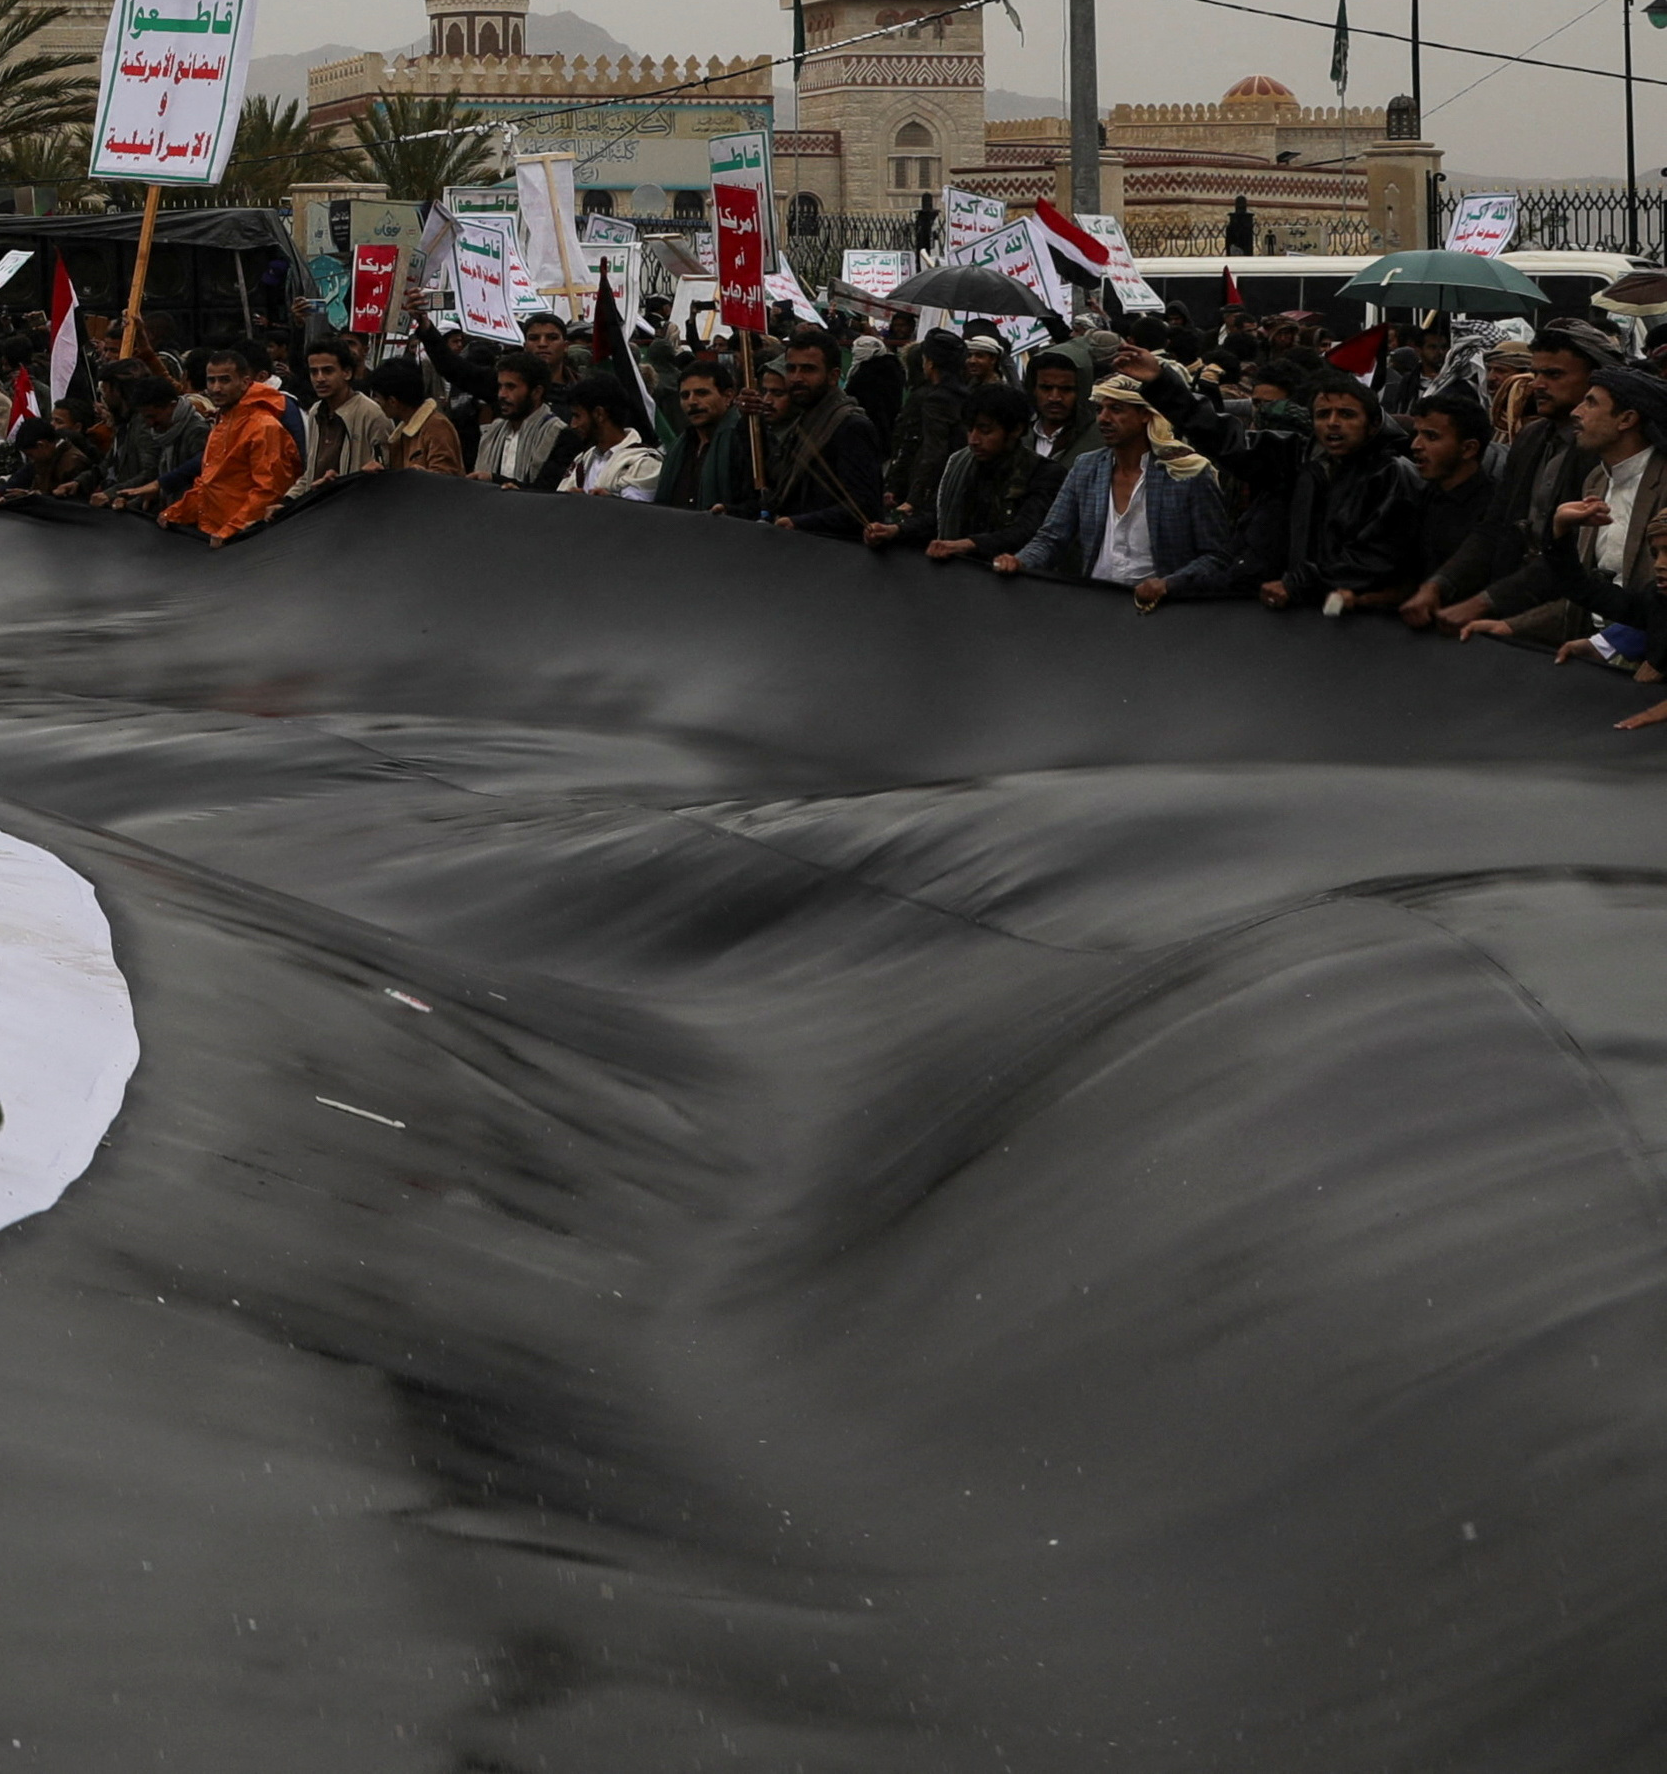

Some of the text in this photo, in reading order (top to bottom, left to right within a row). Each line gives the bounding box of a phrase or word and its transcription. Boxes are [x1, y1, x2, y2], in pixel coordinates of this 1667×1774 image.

[120, 47, 226, 86] البضائع الأمريكية
[157, 91, 168, 116] و
[104, 127, 212, 164] الإسرائيلية
[951, 198, 1004, 218] الله أكبر
[1461, 201, 1512, 226] الله أكبر
[719, 207, 758, 235] أمريكا
[1005, 229, 1028, 254] الله
[1477, 228, 1507, 240] الموت
[735, 246, 745, 270] أم
[373, 282, 383, 296] أم
[721, 280, 761, 310] الإرهاب
